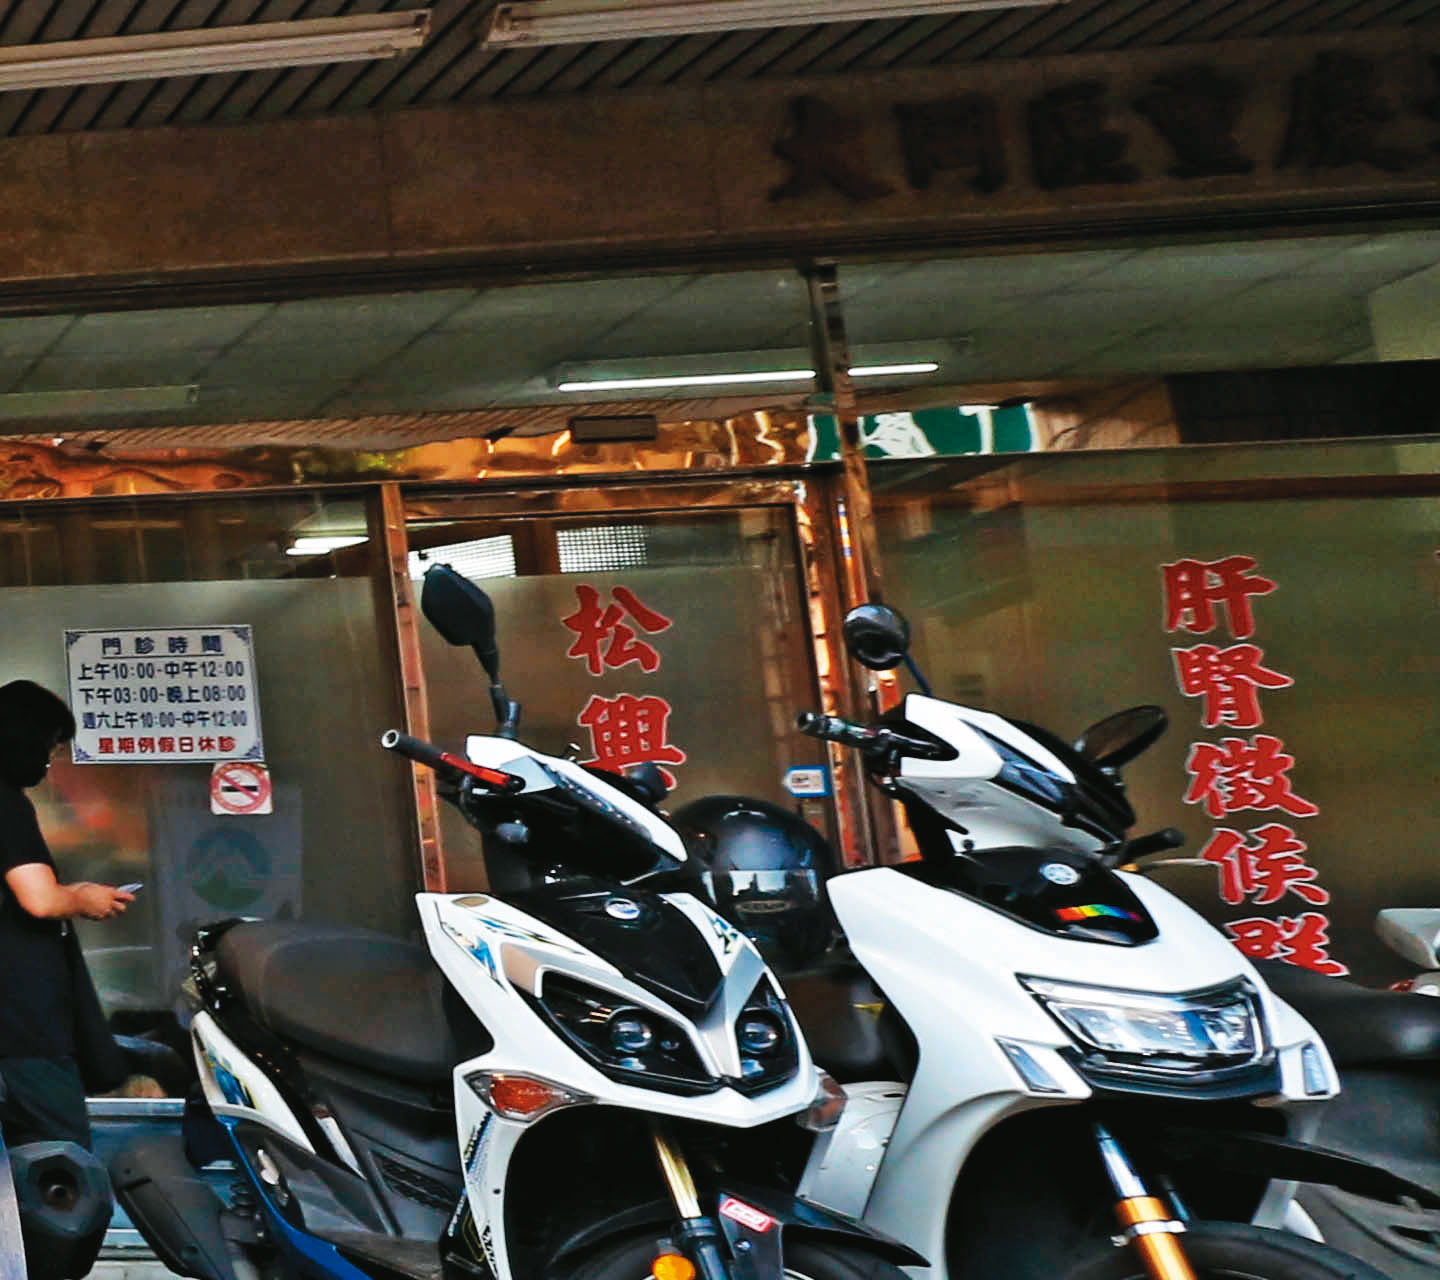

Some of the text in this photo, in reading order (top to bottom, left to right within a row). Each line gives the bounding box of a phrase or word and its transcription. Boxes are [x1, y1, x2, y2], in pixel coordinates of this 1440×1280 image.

[101, 635, 223, 655] 門診時間
[77, 661, 245, 681] 上午10:00-中午12:00
[78, 685, 247, 705] 下午03:00-晚上08:00
[98, 736, 238, 754] 星期例假日休診
